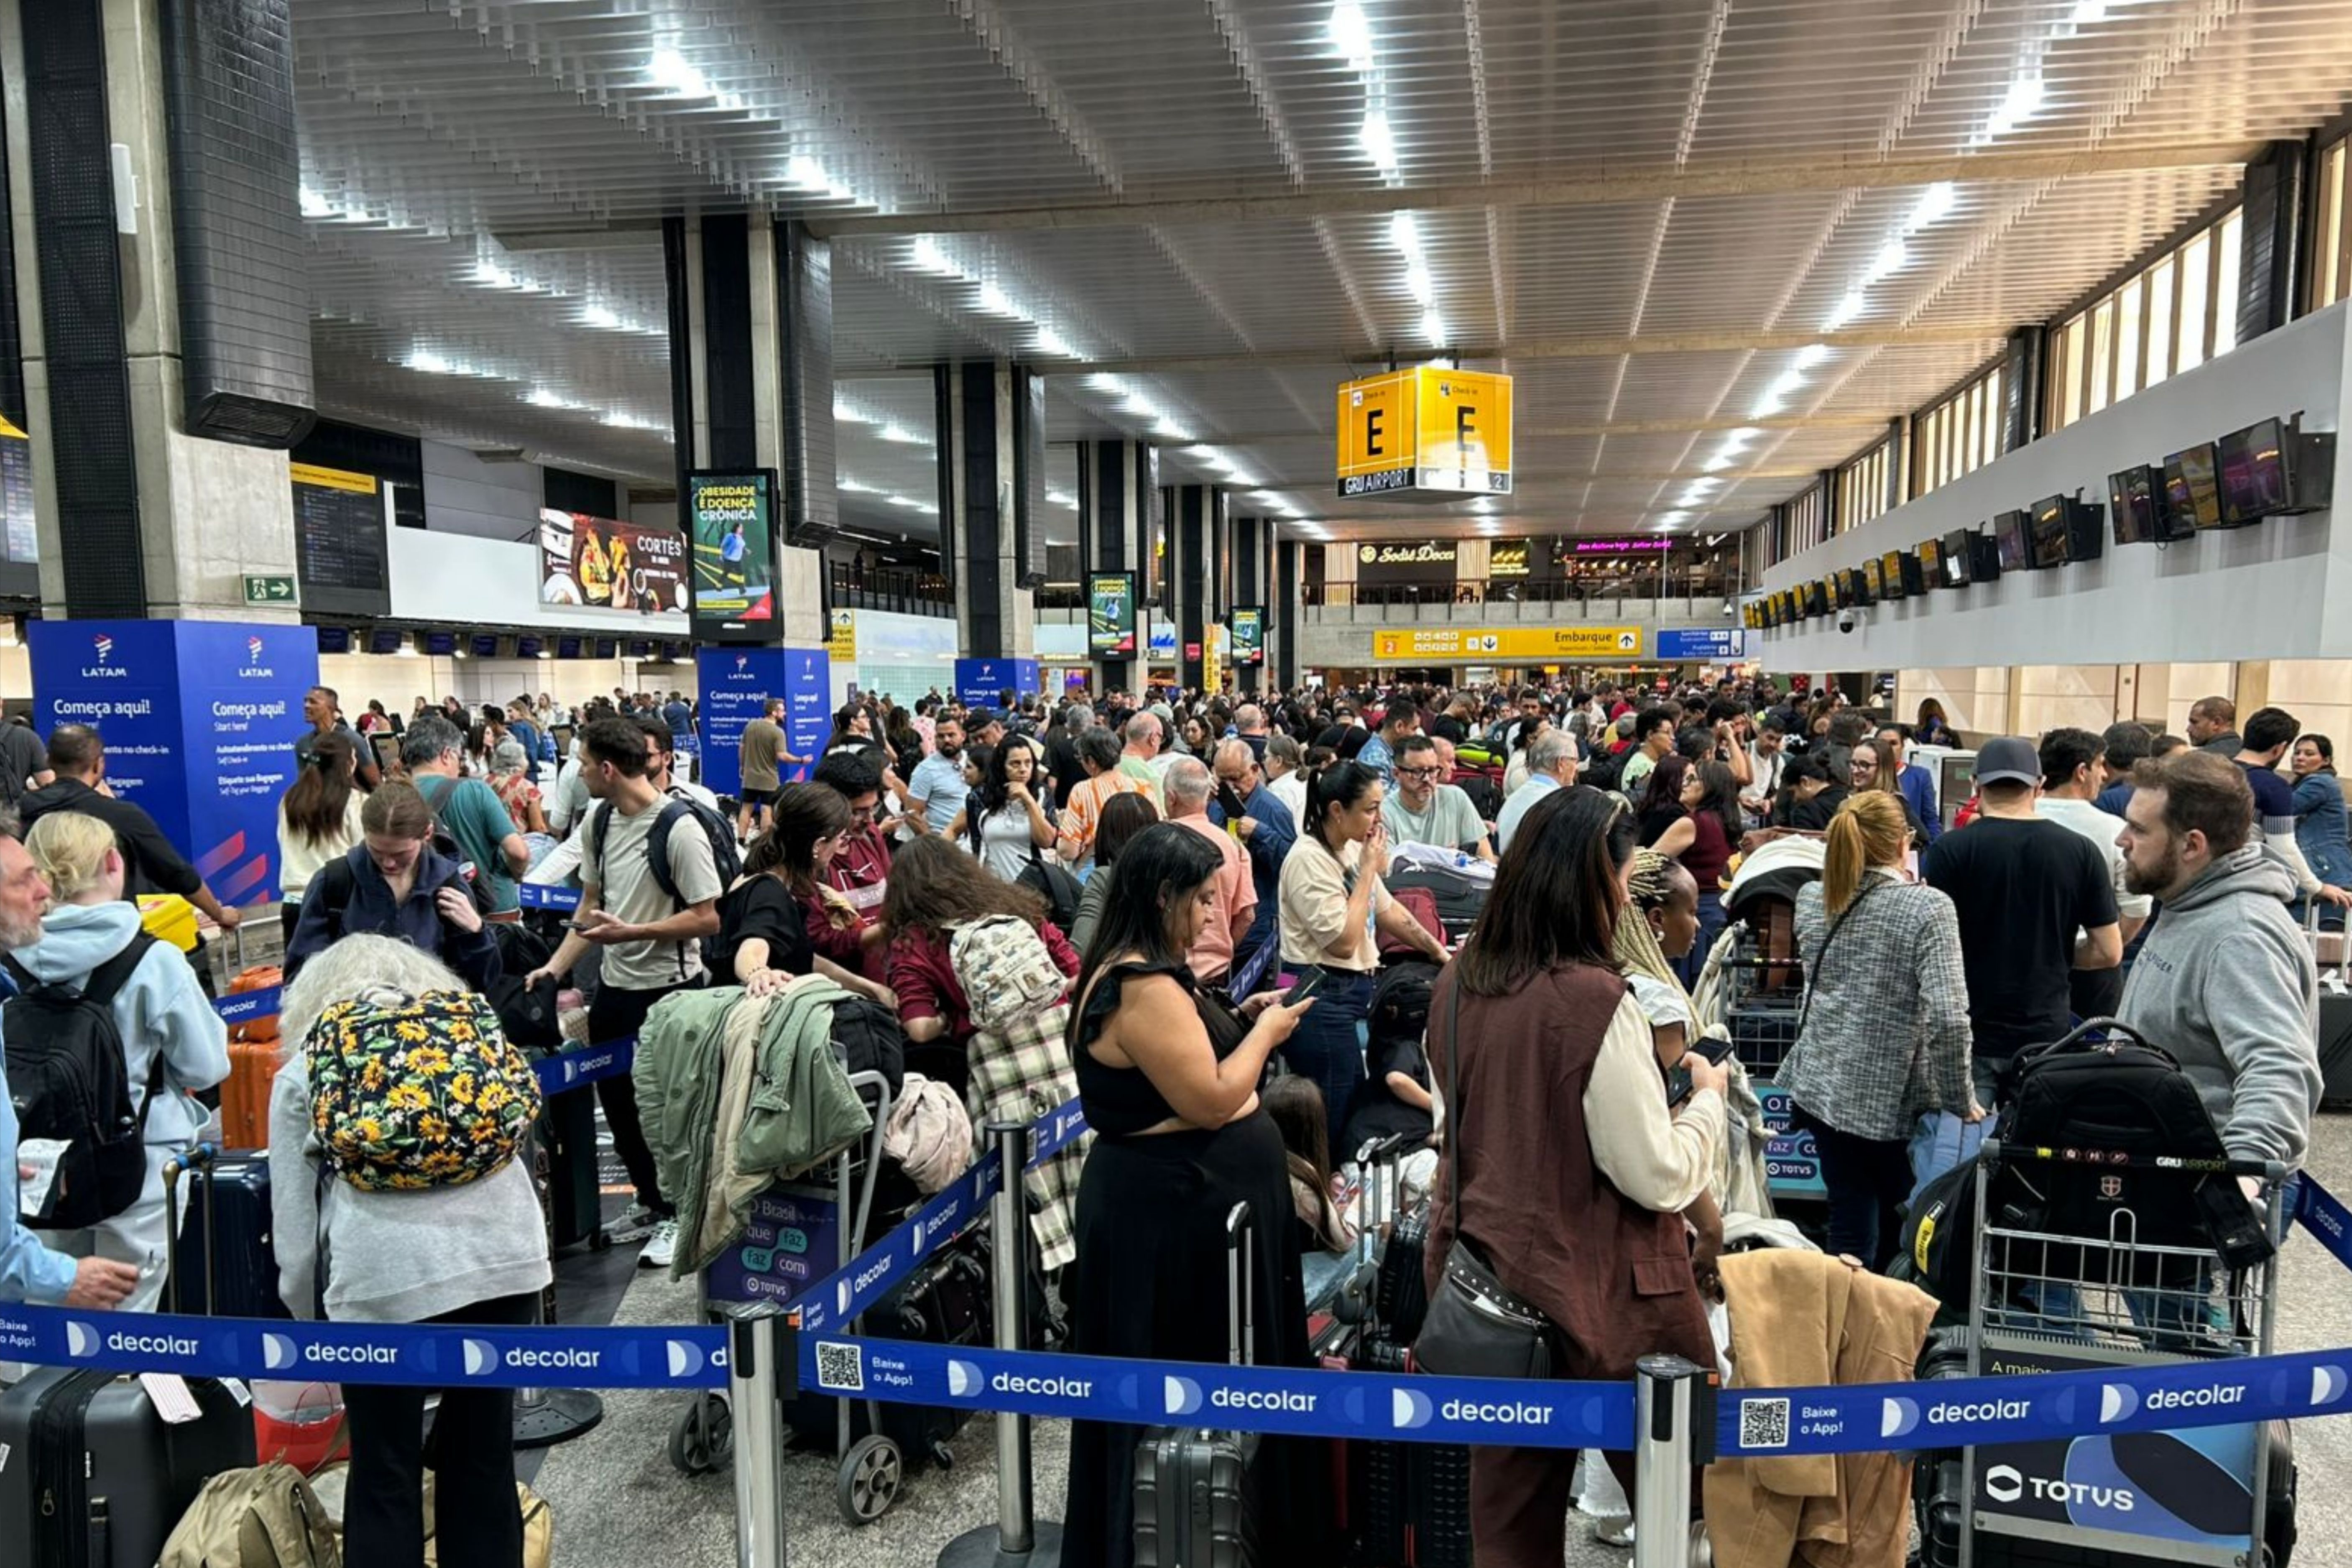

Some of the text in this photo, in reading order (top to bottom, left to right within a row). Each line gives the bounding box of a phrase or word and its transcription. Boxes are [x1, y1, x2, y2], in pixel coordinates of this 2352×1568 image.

[1367, 409, 1383, 456] E
[1457, 405, 1476, 452] E
[1365, 469, 1409, 492] AIRPORT
[699, 486, 756, 496] OBESIDADE
[699, 494, 756, 511] É DOENÇA
[699, 508, 757, 521] CRÔNICA
[637, 535, 682, 557] CORTÉS
[1554, 631, 1612, 644] Embarque
[82, 667, 127, 677] LATAM
[239, 668, 273, 677] LATAM
[710, 690, 745, 703] Começa
[54, 699, 151, 719] Começa aqui!
[212, 700, 286, 720] Começa aqui!
[106, 776, 143, 788] Bagagem
[221, 1000, 257, 1016] decolar
[579, 1053, 613, 1073] decolar
[1767, 1141, 1789, 1152] faz
[1782, 1164, 1812, 1175] TOTVS
[762, 1201, 796, 1221] Brasil
[927, 1199, 959, 1235] decolar
[784, 1231, 803, 1247] faz
[747, 1250, 767, 1266] faz
[779, 1258, 805, 1275] com
[854, 1254, 893, 1293] decolar
[9, 1334, 36, 1348] App!
[107, 1331, 600, 1368] decolar decolar decolar
[872, 1356, 906, 1371] Baixe
[1991, 1360, 2003, 1373] A
[884, 1372, 913, 1387] App!
[991, 1372, 1553, 1425] decolar decolar decolar
[1928, 1384, 2246, 1424] decolar decolar
[1802, 1406, 1837, 1419] Baixe
[1811, 1422, 1844, 1436] App!
[2029, 1477, 2134, 1511] TOTVS
